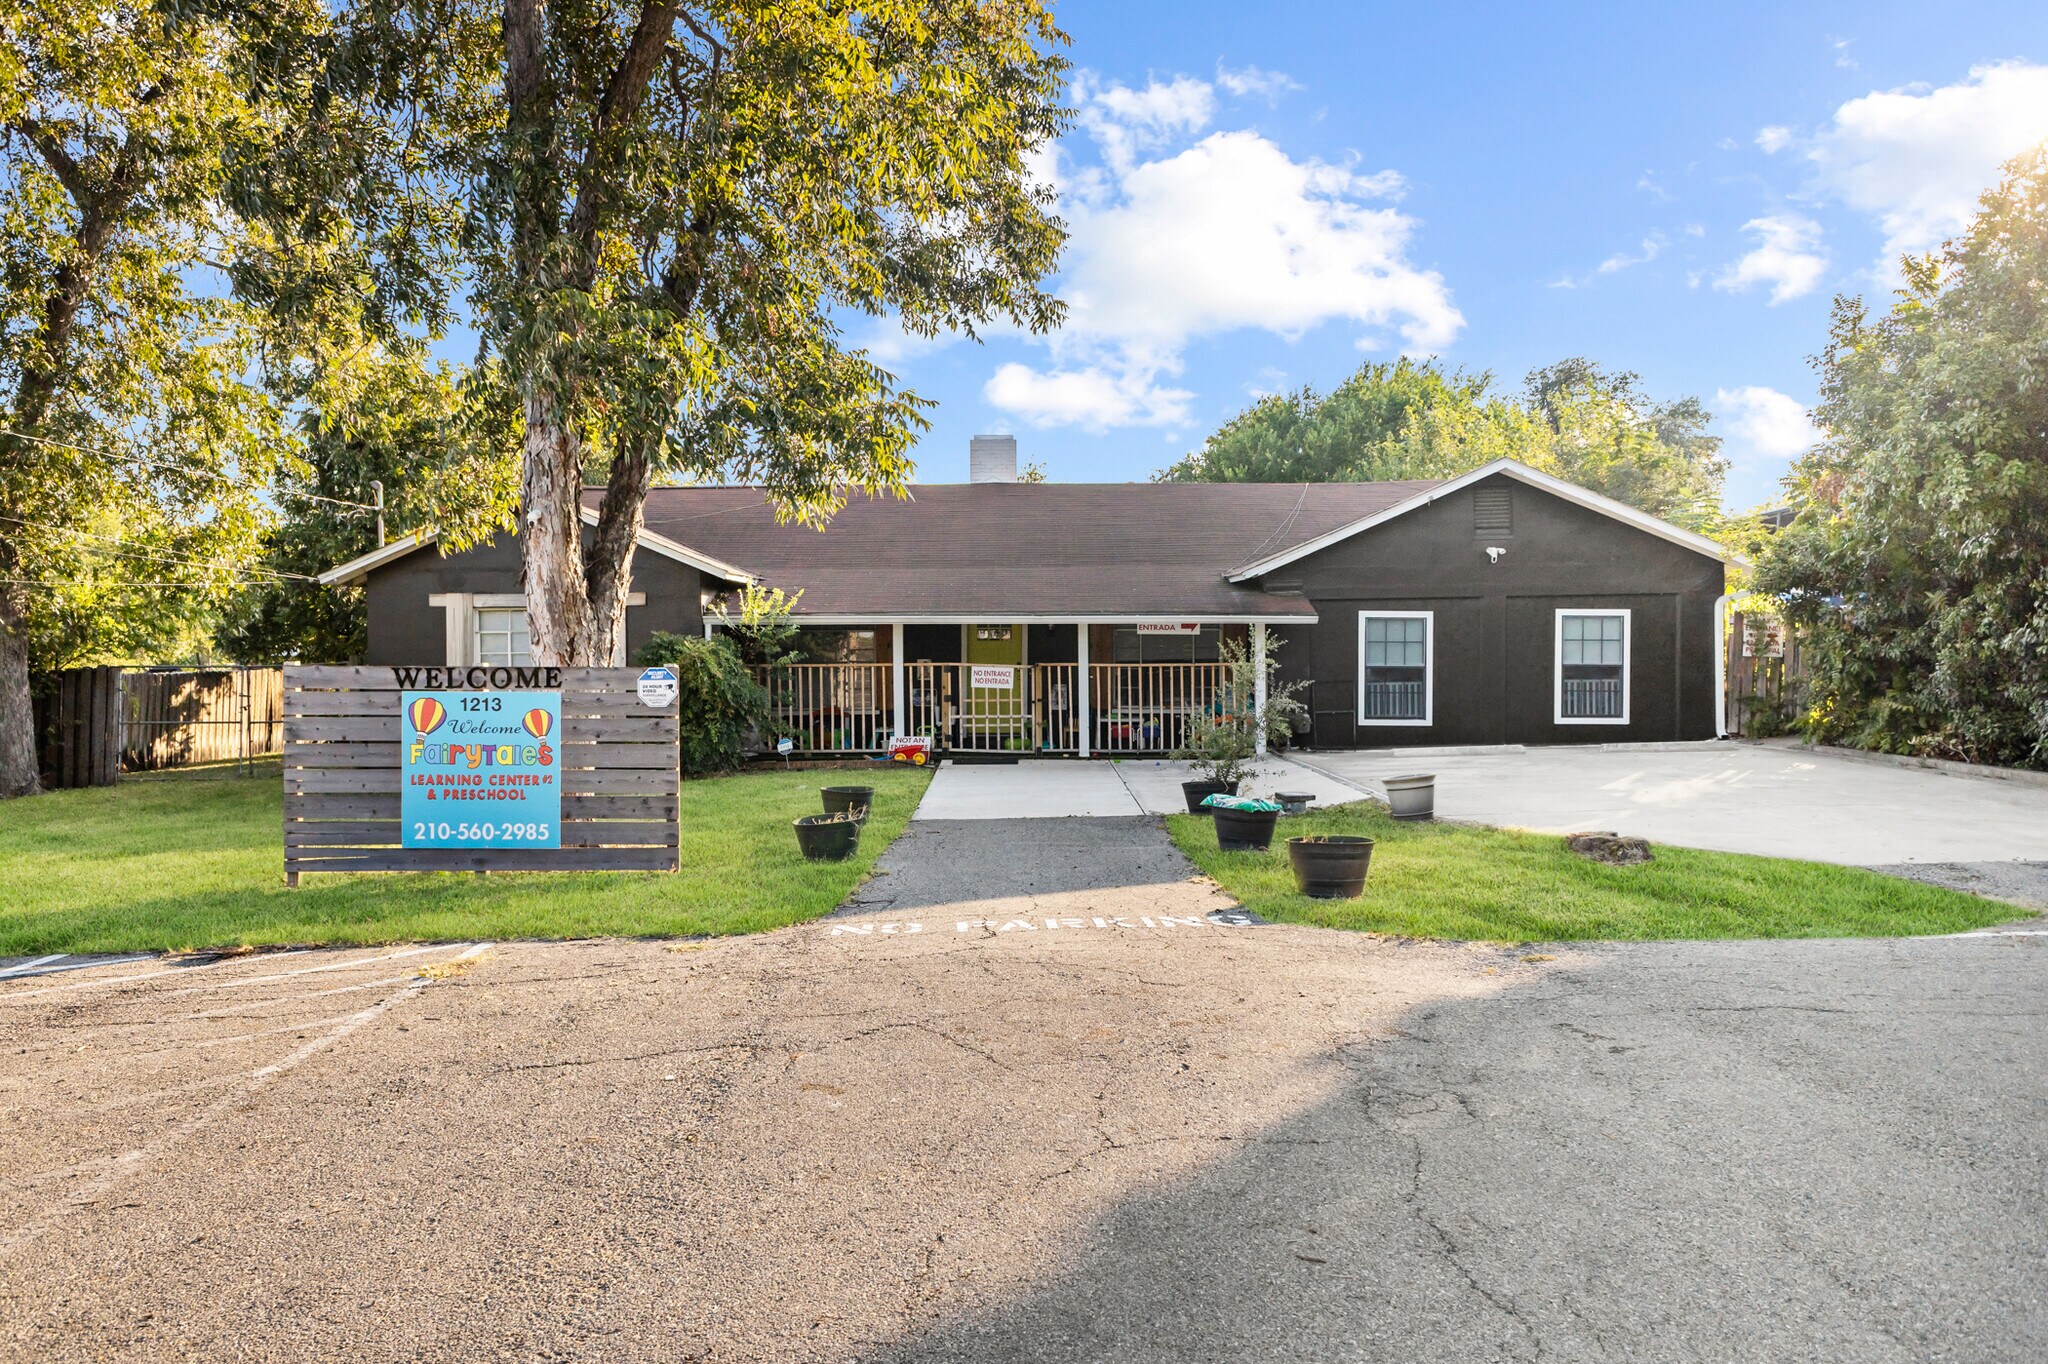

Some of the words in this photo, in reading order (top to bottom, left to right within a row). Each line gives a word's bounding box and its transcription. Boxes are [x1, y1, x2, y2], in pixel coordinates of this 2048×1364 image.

[392, 667, 562, 689] WELCOME
[983, 670, 1011, 678] ENTRANCE
[460, 697, 502, 712] 1213
[447, 719, 522, 735] Welcome
[410, 774, 483, 786] LEARNING
[488, 774, 540, 786] CENTER
[541, 774, 553, 784] #2
[426, 788, 437, 800] &
[443, 788, 527, 800] PRESCHOOL
[413, 822, 550, 841] 210-560-2985
[830, 922, 923, 936] NO
[956, 914, 1253, 933] PARKING
